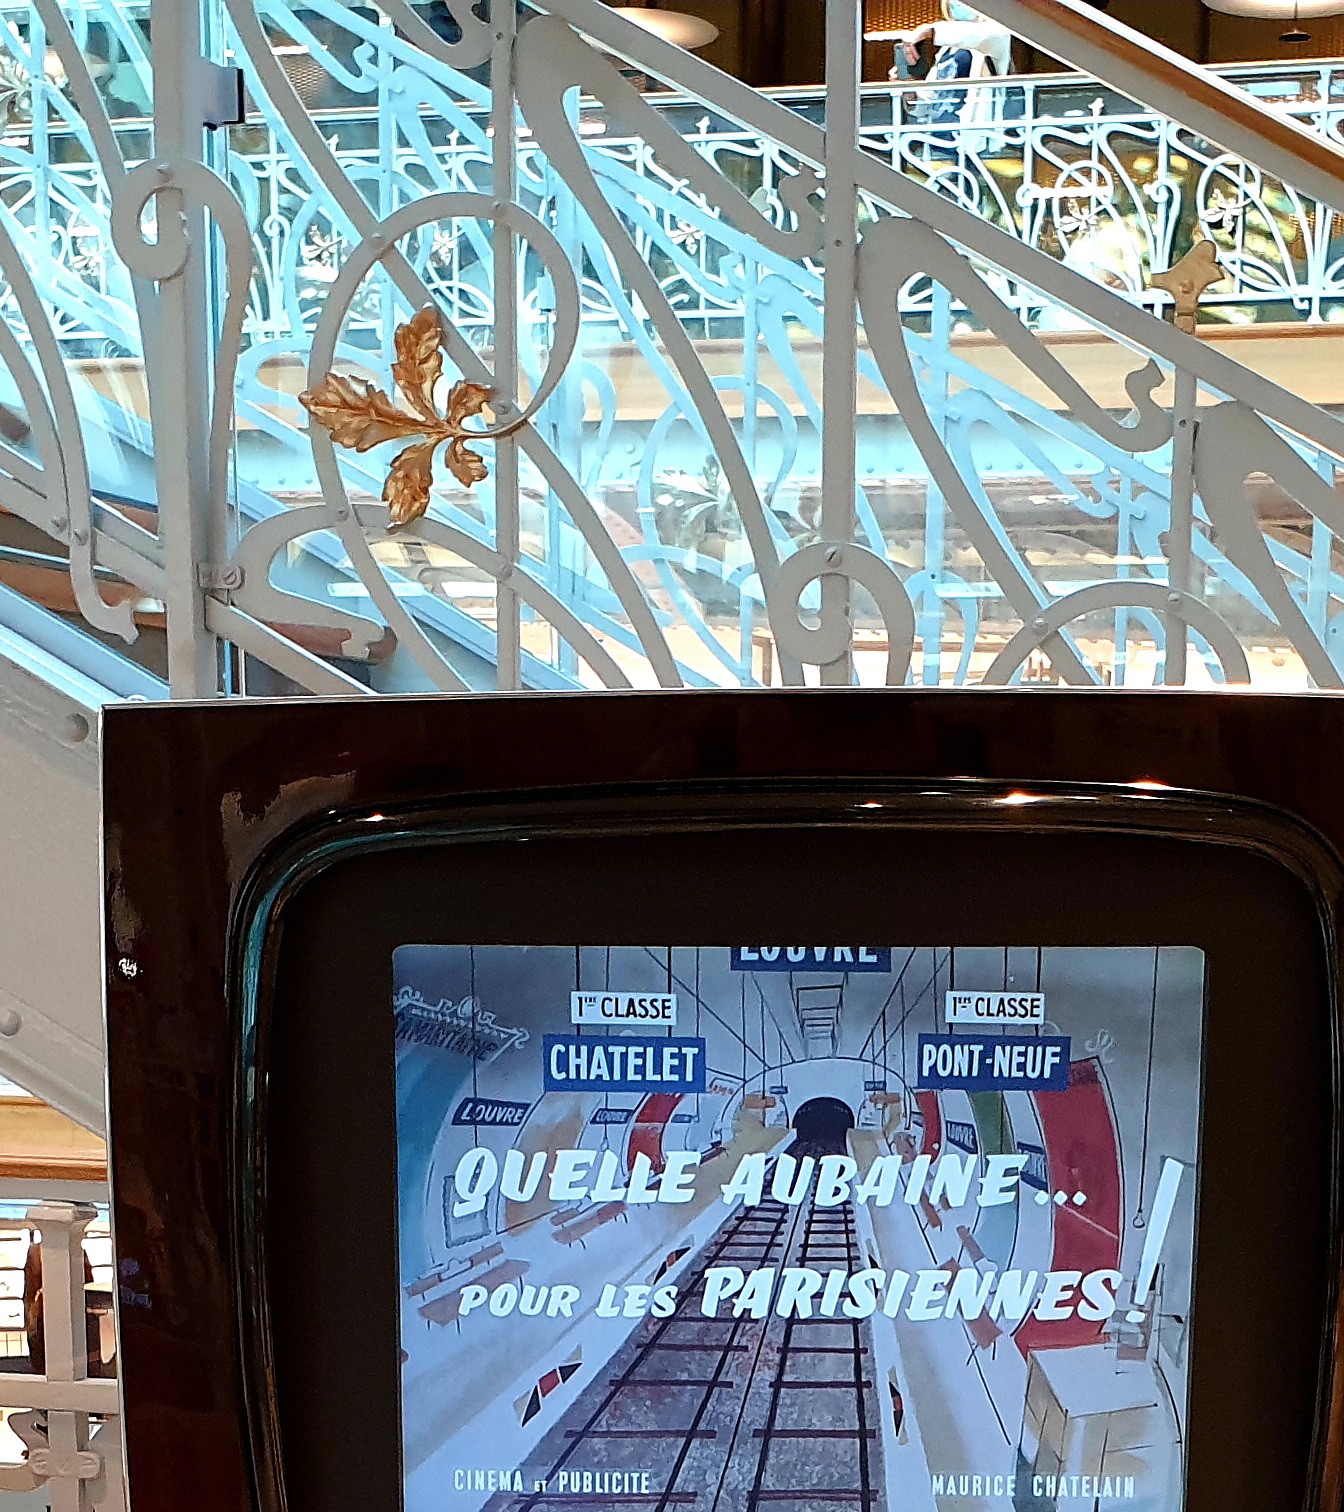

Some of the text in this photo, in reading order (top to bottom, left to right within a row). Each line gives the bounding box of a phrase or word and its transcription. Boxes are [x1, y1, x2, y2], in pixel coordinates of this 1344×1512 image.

[600, 996, 672, 1019] CLASSE
[974, 996, 1041, 1018] CLASSE
[550, 1043, 699, 1082] CHATELET
[921, 1043, 1061, 1079] PONT-NEUF
[460, 1102, 525, 1122] LOUVRE
[453, 1146, 702, 1217] QUELLE
[720, 1152, 1088, 1208] AUBAINE...
[458, 1284, 581, 1318] POUR
[595, 1283, 679, 1318] LES
[454, 1469, 651, 1494] CINEMA ET PUBLICITE
[931, 1474, 1135, 1498] MAURICE CHATELAIN
